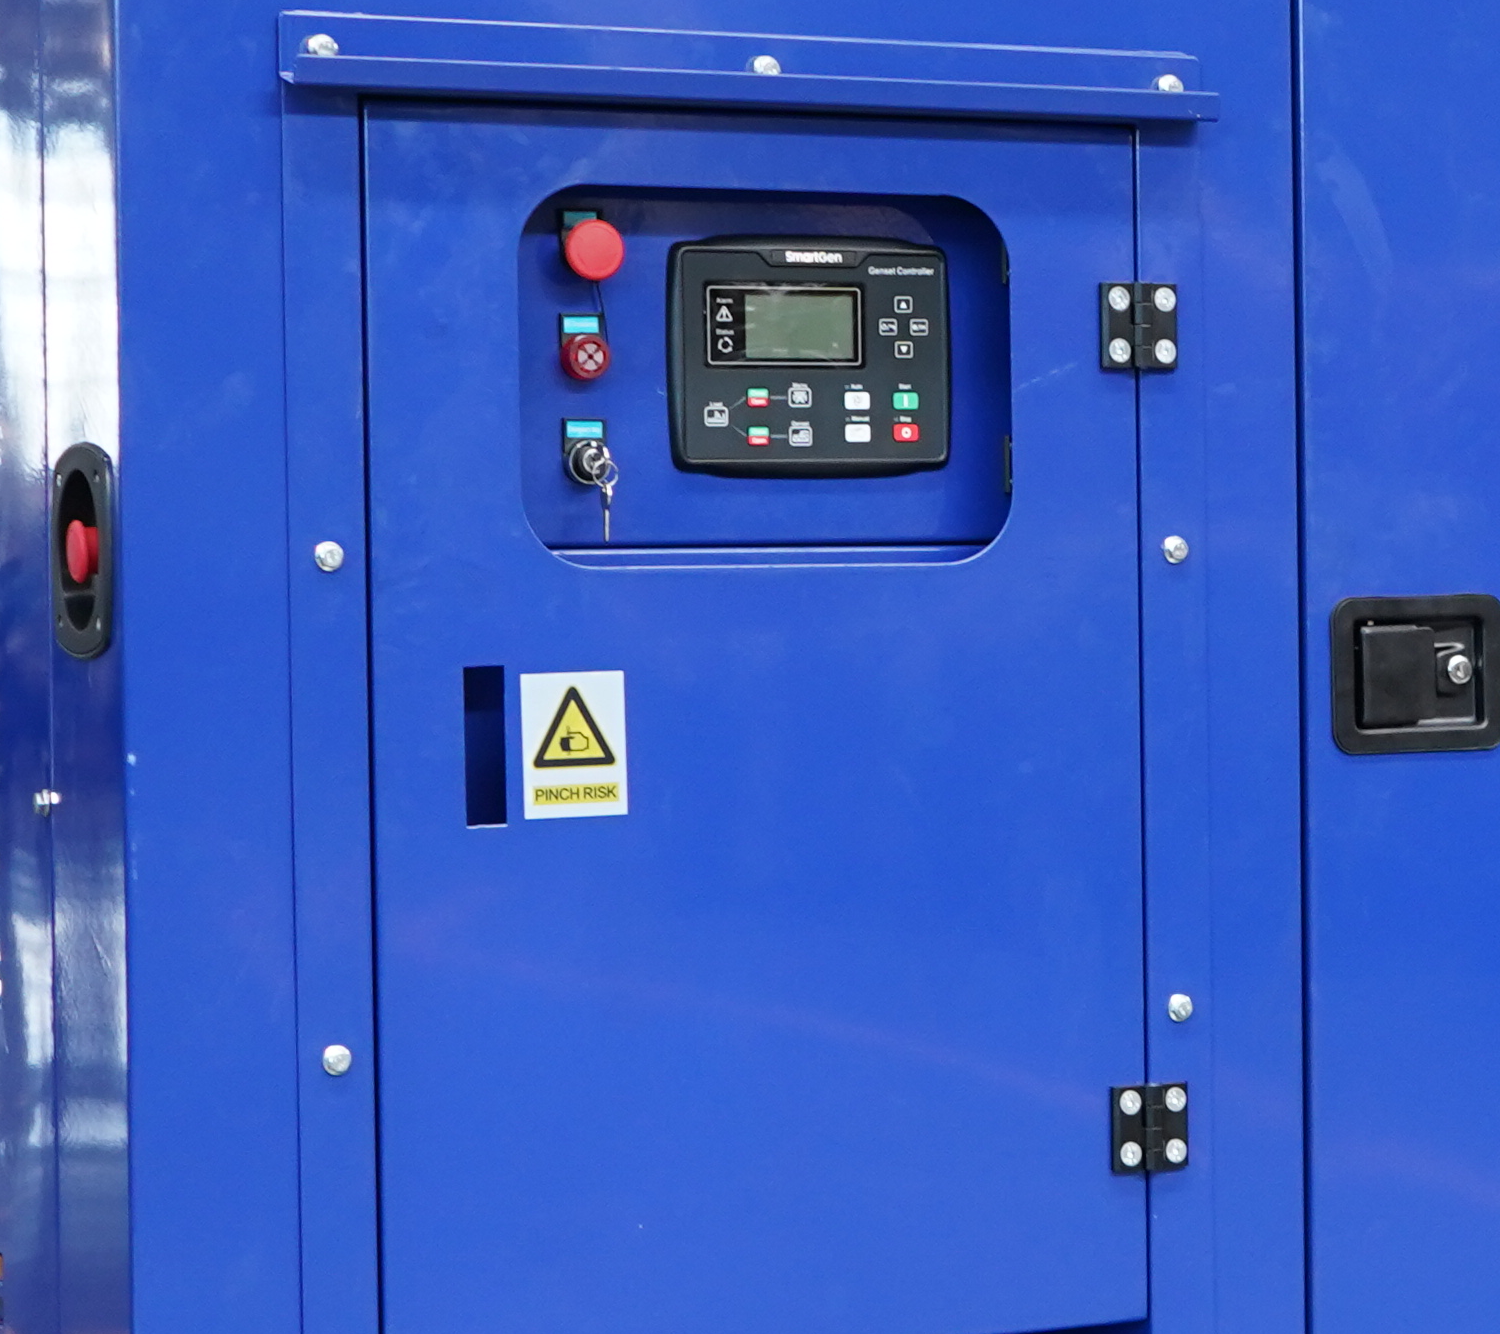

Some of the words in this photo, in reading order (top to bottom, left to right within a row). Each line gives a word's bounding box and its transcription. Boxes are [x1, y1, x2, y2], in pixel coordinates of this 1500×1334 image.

[785, 250, 843, 264] SmartGen
[896, 266, 935, 276] Controller
[535, 787, 580, 802] PINCH
[583, 785, 617, 799] RISK
